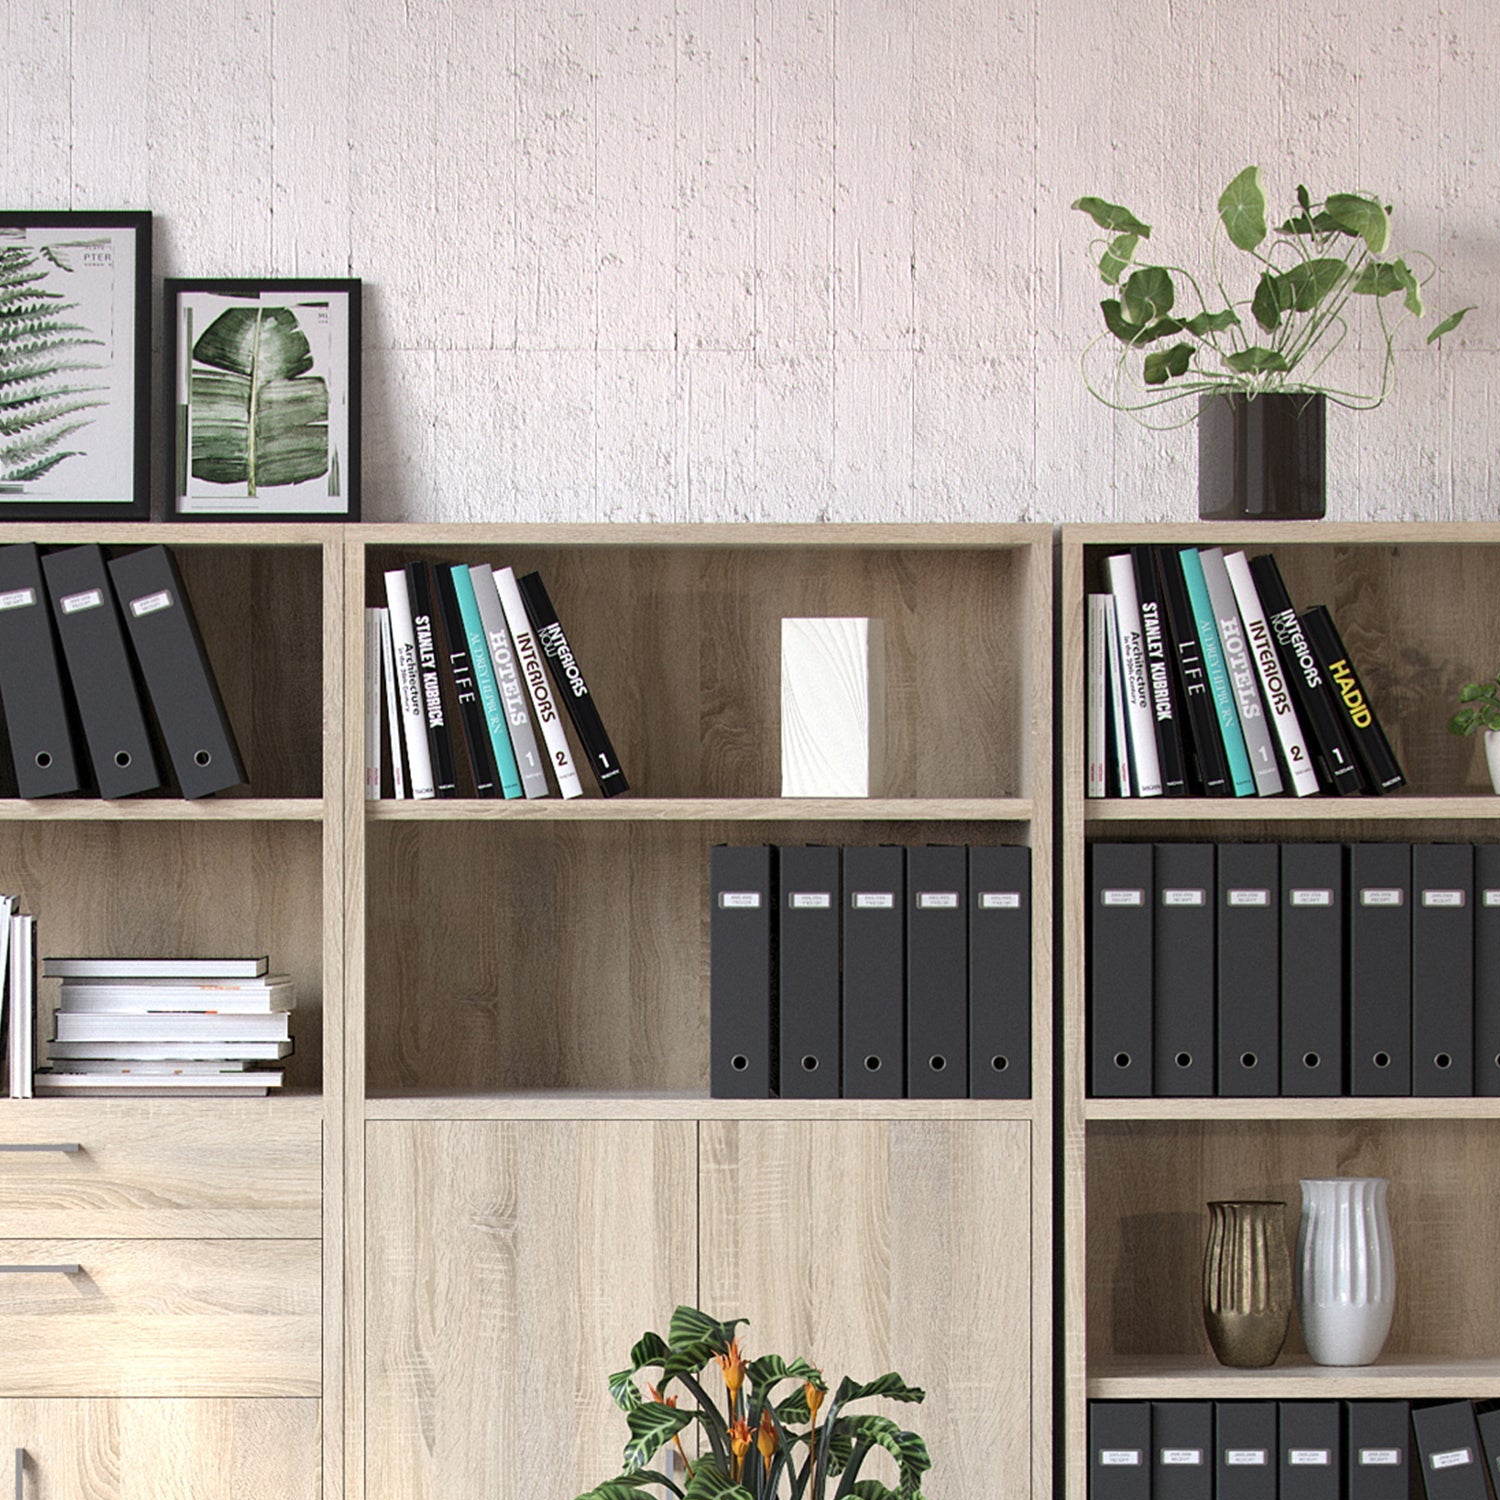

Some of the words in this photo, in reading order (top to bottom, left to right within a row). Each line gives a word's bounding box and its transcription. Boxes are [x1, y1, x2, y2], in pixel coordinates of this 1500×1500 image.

[415, 615, 436, 668] STANLEY
[537, 627, 557, 658] NOW
[548, 622, 588, 697] INTERIORS
[1142, 602, 1164, 658] STANLEY
[1270, 613, 1291, 646] NOW
[1281, 608, 1322, 689] INTERIORS
[404, 642, 420, 716] Architecture
[423, 671, 444, 728] KUBRICK
[450, 652, 476, 704] LIFE
[469, 632, 490, 681] AUDREY
[482, 678, 503, 734] HEPBURN
[489, 629, 527, 726] HOTELS
[525, 751, 534, 767] 1
[516, 632, 556, 723] INTERIORS
[555, 751, 568, 766] 2
[1131, 631, 1147, 708] Architecture
[1150, 662, 1172, 721] KUBRICK
[1179, 641, 1205, 696] LIFE
[1200, 620, 1221, 670] AUDREY
[1212, 669, 1235, 727] HEPBURN
[1220, 616, 1261, 719] HOTELS
[1258, 745, 1268, 762] 1
[1249, 620, 1291, 715] INTERIORS
[1290, 745, 1303, 762] 2
[1328, 659, 1372, 728] HADID
[598, 753, 611, 769] 1
[1332, 747, 1344, 764] 1
